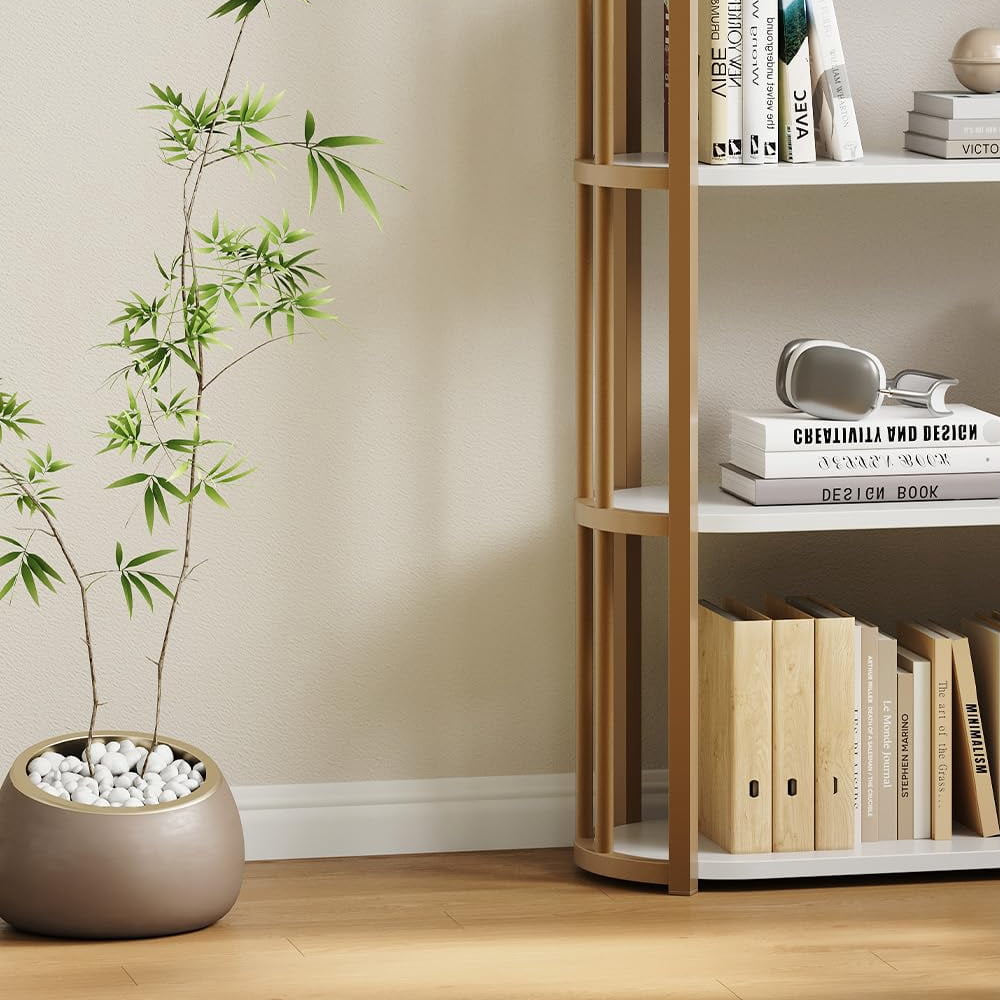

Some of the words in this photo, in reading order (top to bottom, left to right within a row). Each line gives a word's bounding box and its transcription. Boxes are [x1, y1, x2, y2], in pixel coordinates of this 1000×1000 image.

[938, 680, 948, 698] The
[883, 700, 891, 712] Le
[938, 703, 946, 719] art
[883, 715, 891, 749] Monde
[938, 726, 948, 737] of
[966, 704, 987, 774] MINIMALISM
[938, 744, 948, 759] the
[882, 751, 891, 788] Journal
